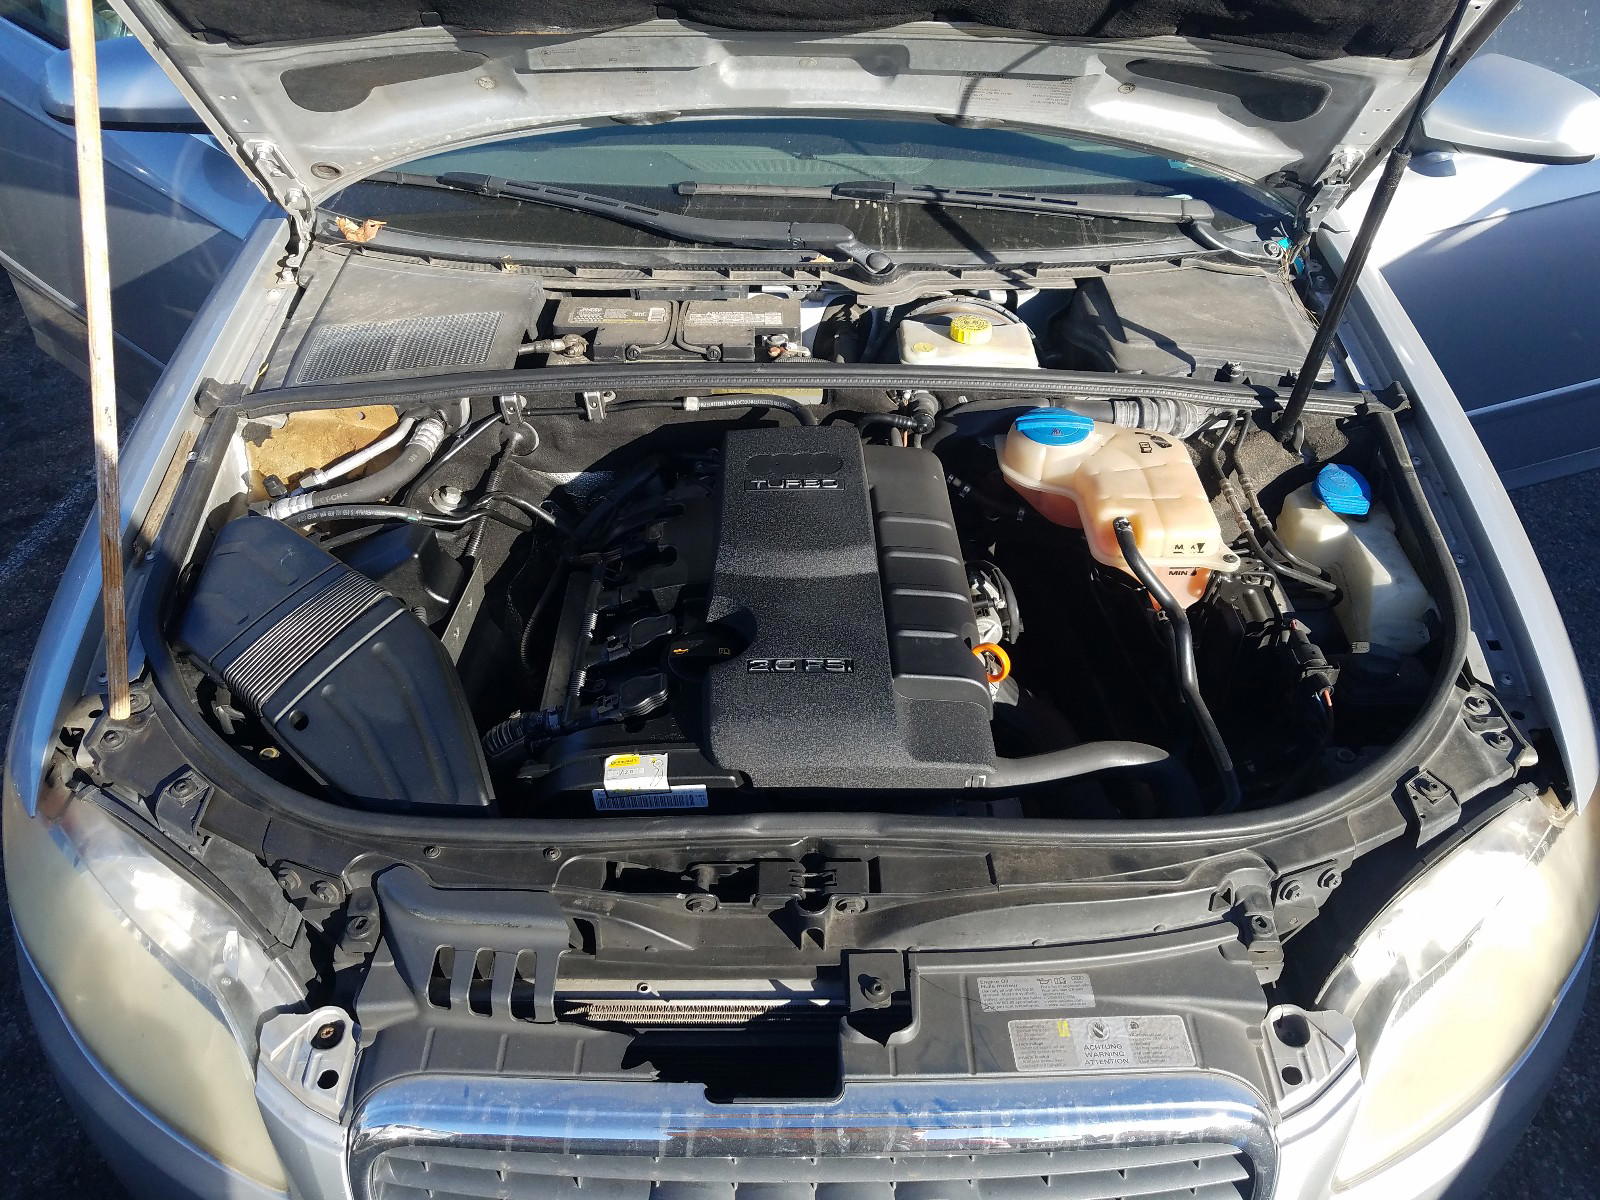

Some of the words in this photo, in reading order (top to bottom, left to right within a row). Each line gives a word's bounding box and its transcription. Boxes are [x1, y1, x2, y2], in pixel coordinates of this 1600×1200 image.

[750, 479, 839, 489] TURBO
[748, 659, 796, 672] 2.0
[804, 659, 853, 672] FSI
[1084, 1043, 1123, 1051] ACHTUNG
